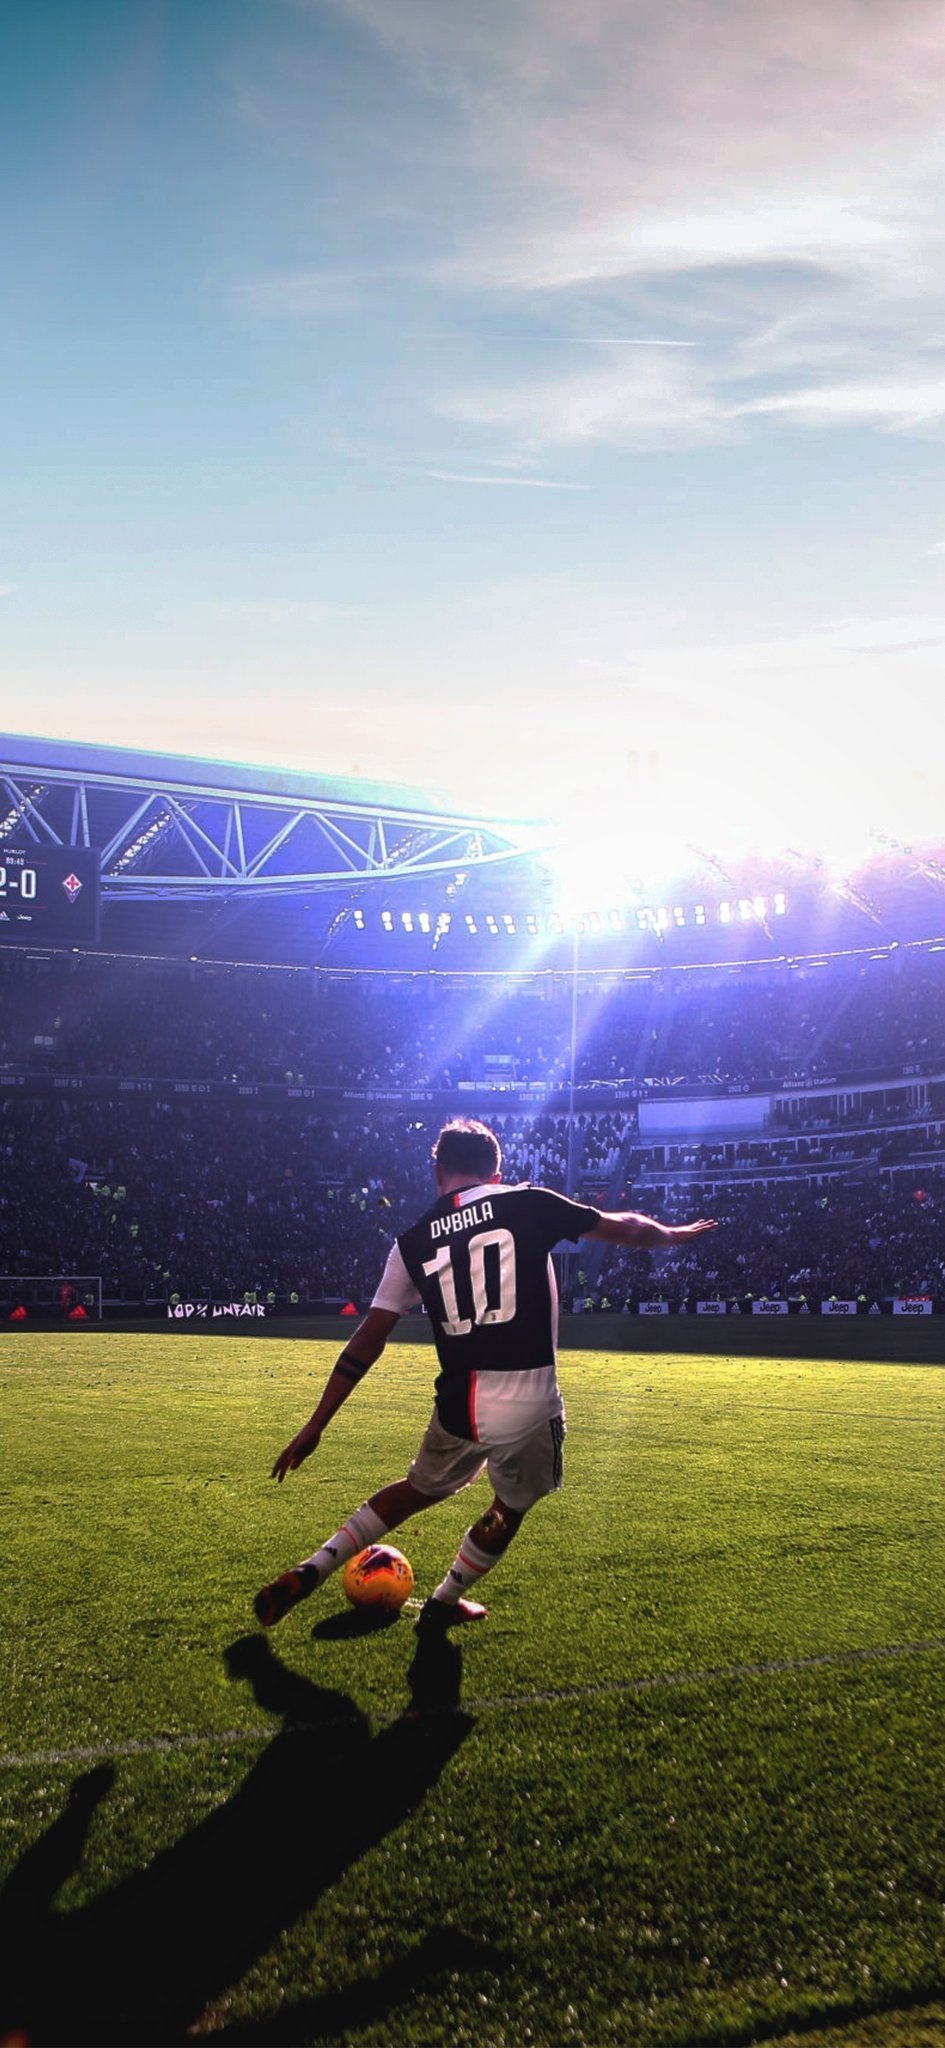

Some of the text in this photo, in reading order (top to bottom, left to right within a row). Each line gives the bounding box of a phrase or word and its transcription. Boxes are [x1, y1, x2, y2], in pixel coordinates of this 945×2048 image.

[430, 1201, 494, 1239] DYBALA
[422, 1228, 517, 1336] 10
[212, 1303, 266, 1317] UNFAIR
[645, 1302, 662, 1313] Jeep
[702, 1302, 720, 1313] Jeep
[759, 1302, 780, 1313] Jeep
[829, 1302, 849, 1313] Jeep
[901, 1301, 924, 1315] Jeep
